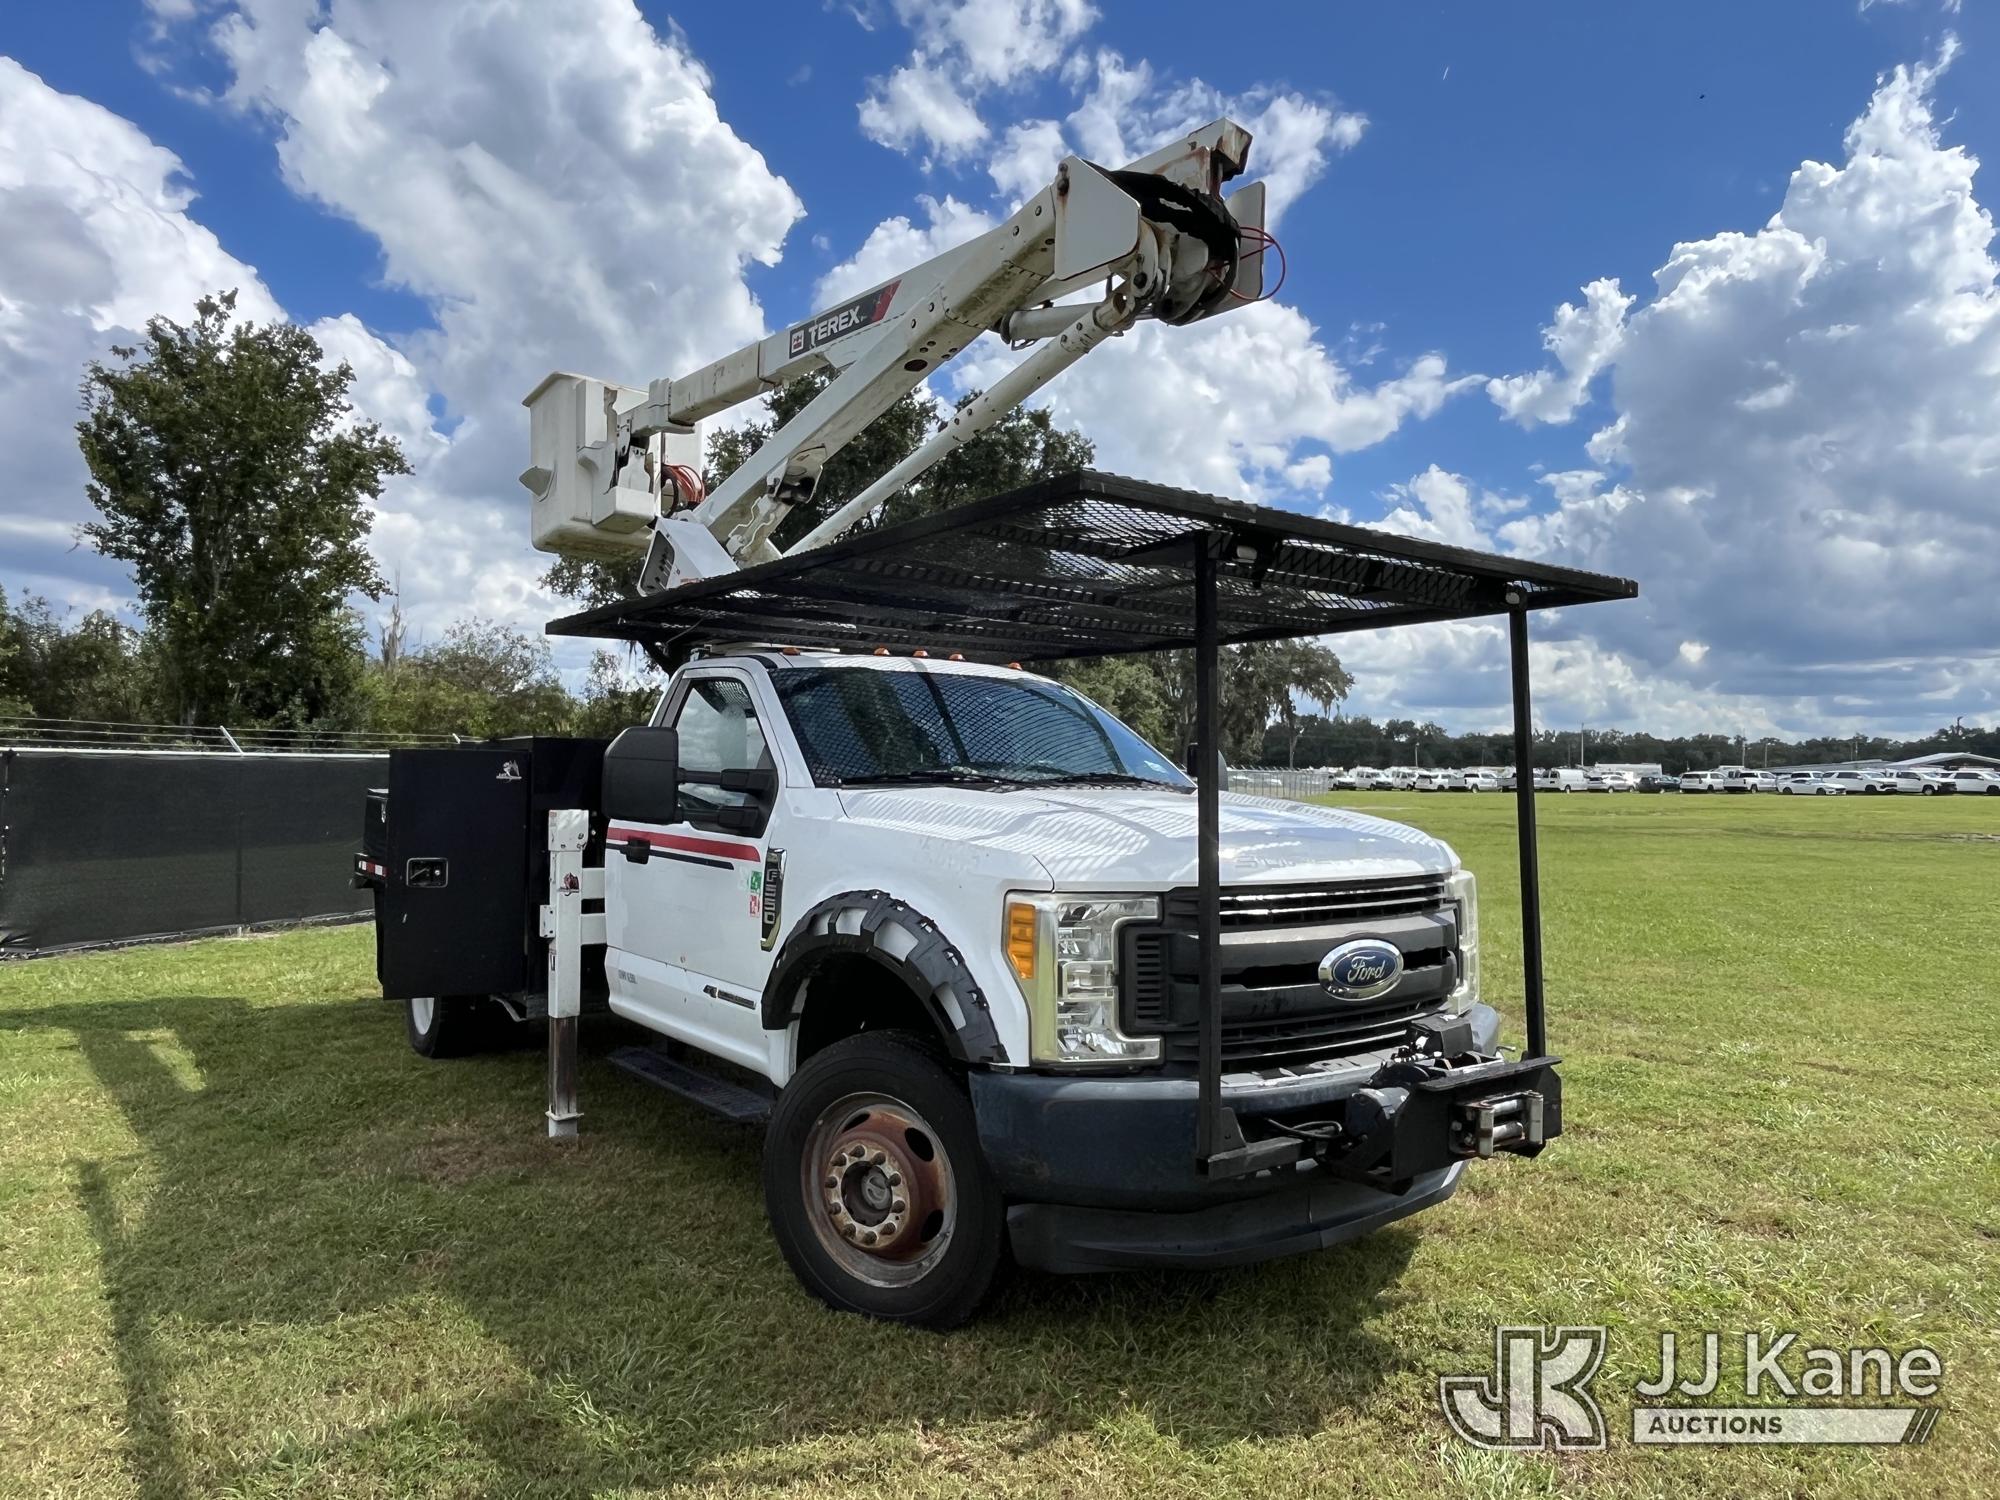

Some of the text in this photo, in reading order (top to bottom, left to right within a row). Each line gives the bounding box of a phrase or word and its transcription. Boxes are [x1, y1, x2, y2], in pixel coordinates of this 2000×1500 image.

[808, 305, 860, 348] TEREX
[763, 868, 778, 925] F550
[1347, 955, 1386, 983] Ford
